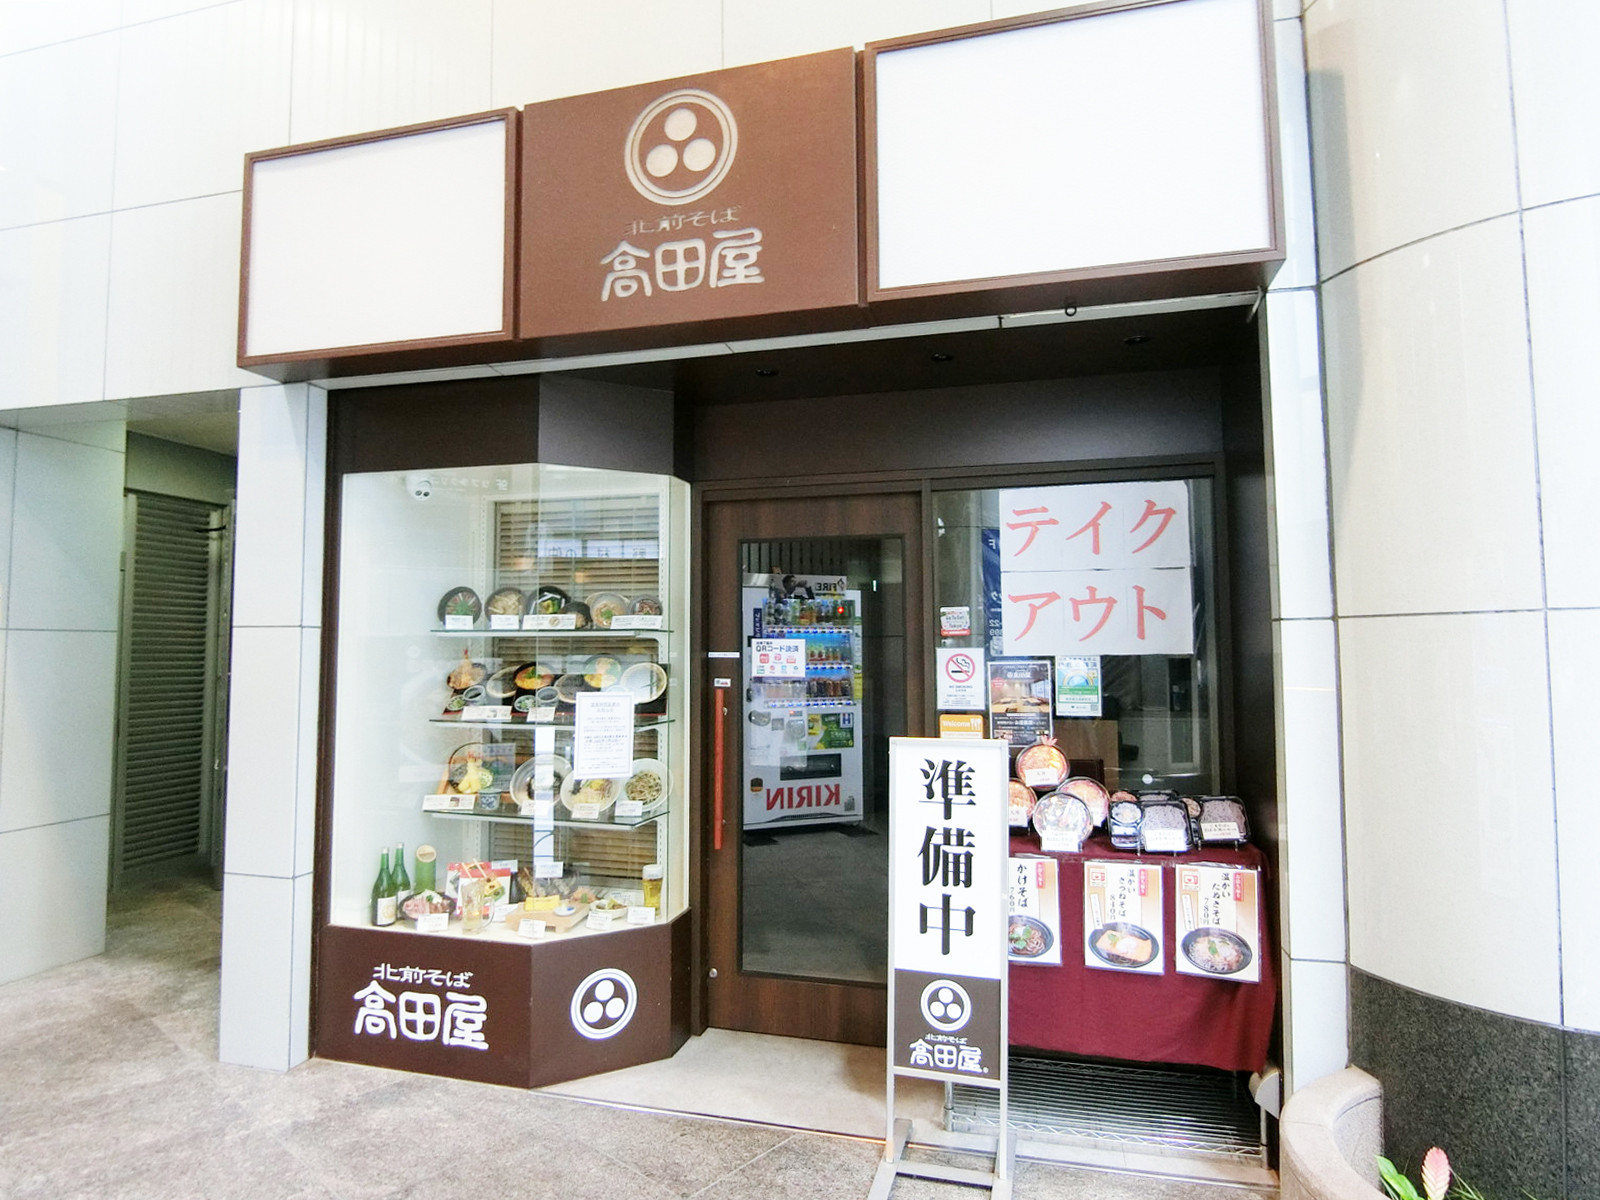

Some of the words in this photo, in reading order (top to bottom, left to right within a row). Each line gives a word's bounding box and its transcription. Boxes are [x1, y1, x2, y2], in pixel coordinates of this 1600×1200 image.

[625, 205, 742, 236] 北前そば
[600, 227, 765, 301] 高田屋
[1005, 499, 1177, 557] テイク
[1008, 585, 1167, 642] アウト
[756, 645, 799, 653] QRコード決済
[942, 719, 971, 730] Welcome
[917, 758, 977, 956] 準備中
[1017, 864, 1028, 908] かけそば
[1119, 877, 1127, 917] きつねそば
[1212, 882, 1221, 925] たぬきそば
[372, 963, 474, 989] 北前そば
[353, 979, 490, 1051] 高田屋
[909, 1038, 983, 1073] 高田屋
